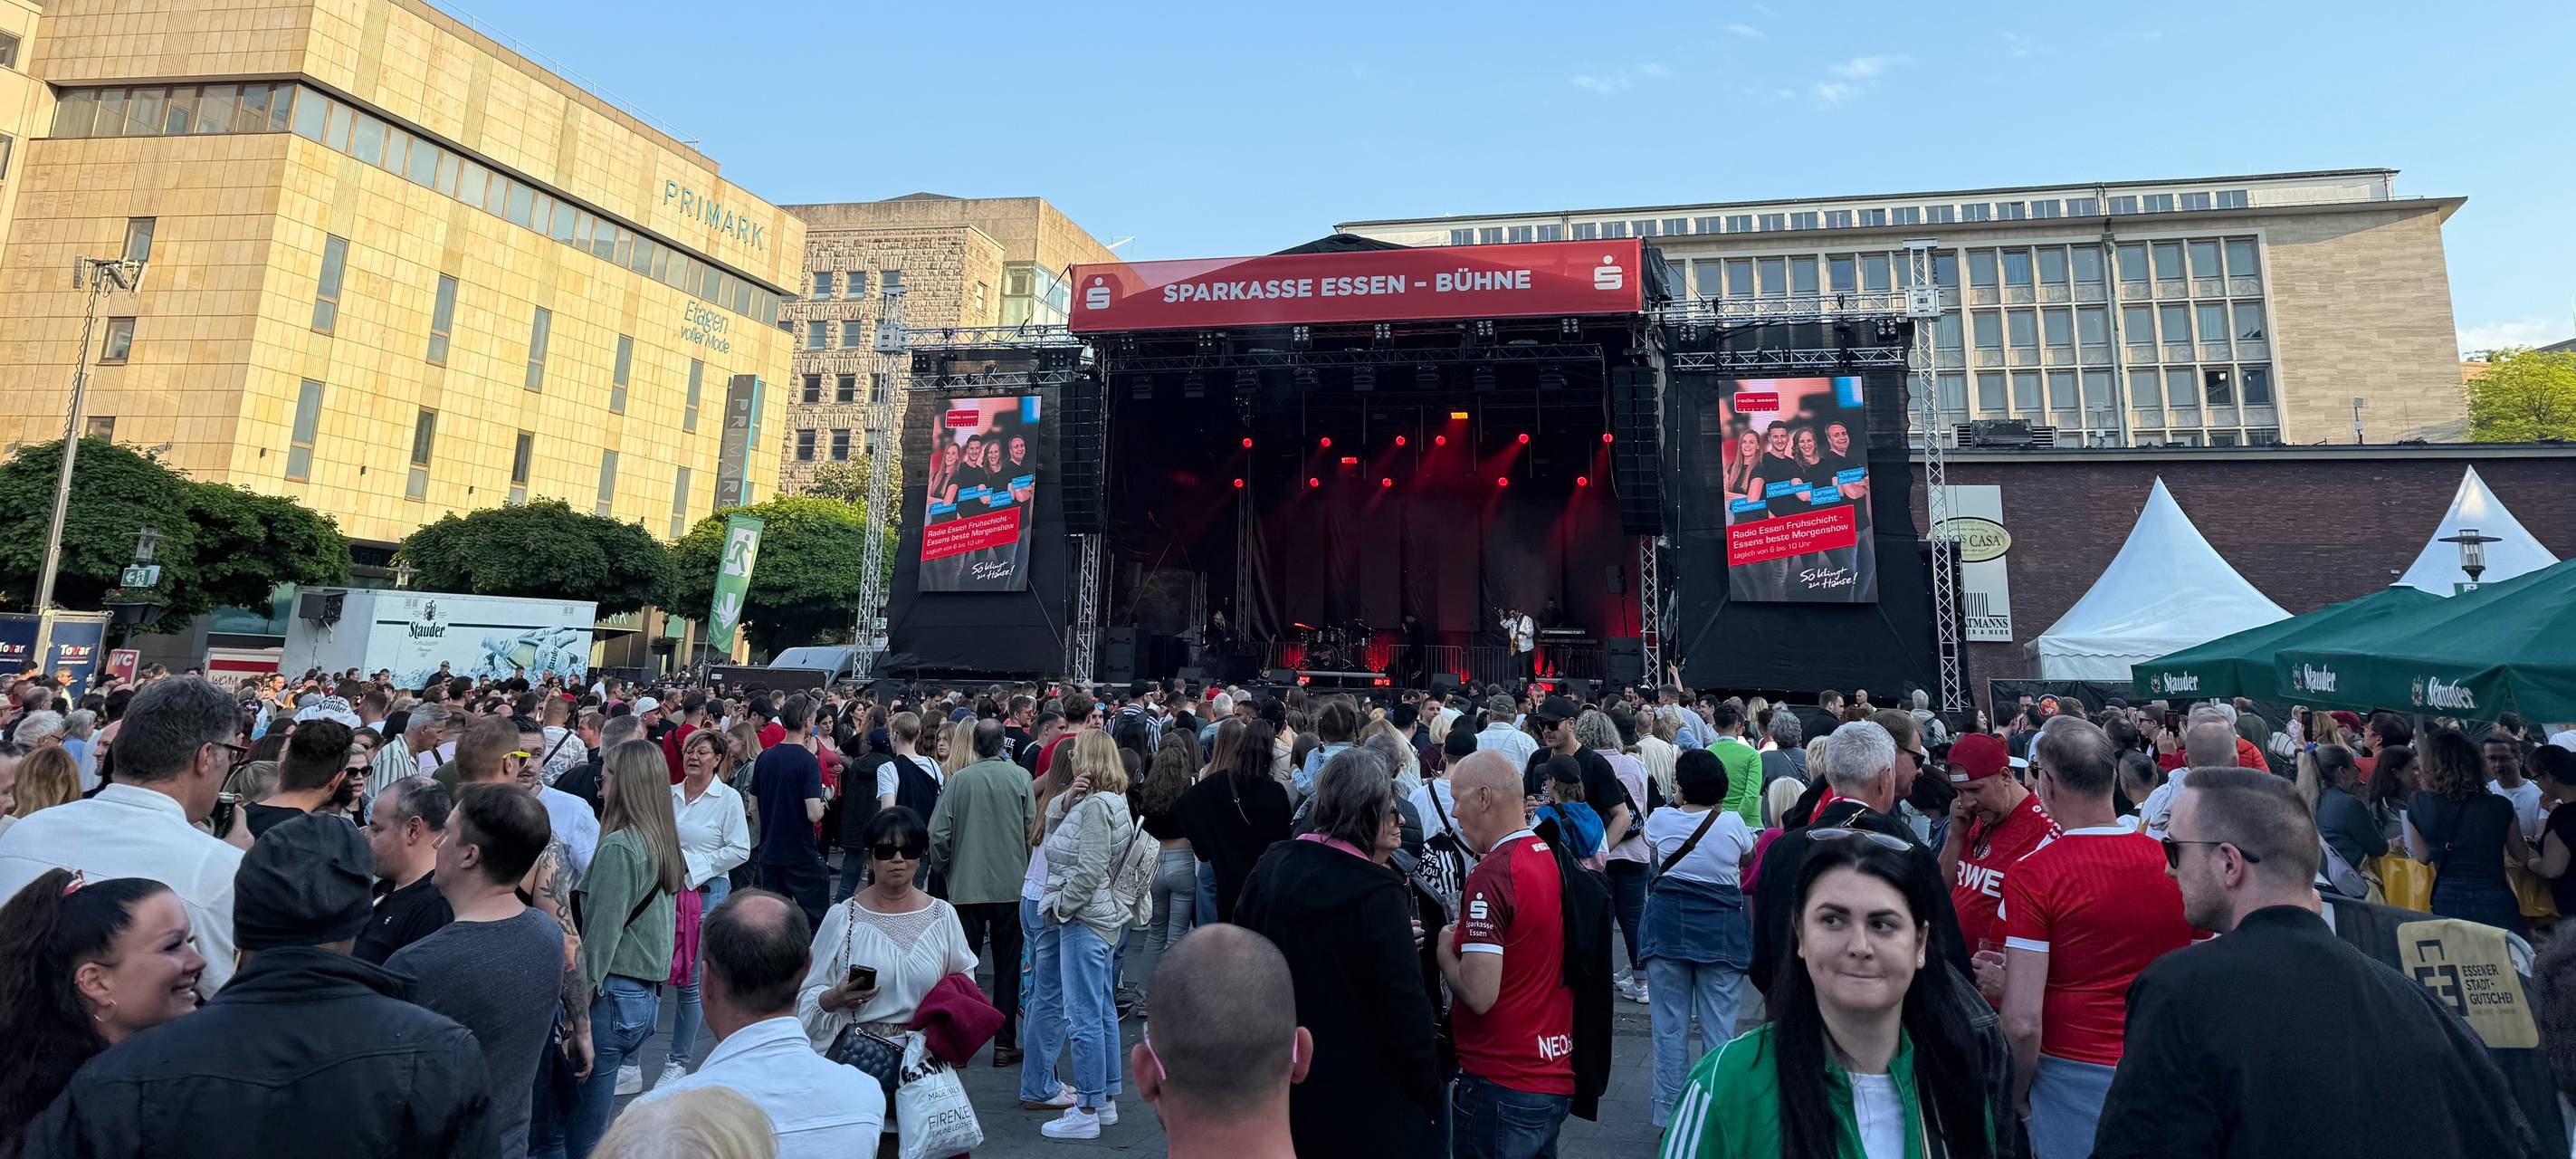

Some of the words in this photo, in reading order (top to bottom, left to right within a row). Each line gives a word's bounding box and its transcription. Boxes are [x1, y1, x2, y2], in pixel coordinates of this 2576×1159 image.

[663, 179, 766, 251] PRIMARK
[1163, 278, 1312, 303] SPARKASSE
[1321, 274, 1406, 297] ESSEN
[1436, 268, 1531, 292] BÜHNE
[683, 300, 730, 335] Etagen
[681, 325, 704, 347] voller
[705, 332, 730, 355] Mode
[927, 537, 950, 547] Essens
[951, 532, 970, 541] beste
[971, 523, 1015, 537] Morgenshow
[928, 530, 947, 538] Radio
[947, 524, 968, 534] Essen
[1732, 529, 1757, 539] Radio
[1759, 524, 1785, 535] Essen
[1733, 538, 1764, 550] Essens
[1766, 533, 1790, 544] beste
[1792, 523, 1848, 539] Morgenshow
[1757, 547, 1769, 555] von
[1770, 545, 1775, 553] 6
[1776, 544, 1787, 552] bis
[1798, 541, 1812, 549] Uhr
[1970, 534, 2001, 547] CASA
[971, 561, 984, 575] So
[984, 560, 1008, 572] klingt
[1799, 568, 1815, 583] So
[1816, 566, 1847, 580] klingt
[1808, 580, 1820, 589] zu
[408, 621, 445, 640] Stauder
[1967, 618, 2008, 628] TMANNS
[0, 642, 25, 653] Tovar
[60, 645, 91, 656] Tovar
[111, 653, 134, 666] WC
[2163, 670, 2199, 694] Stauder
[2304, 663, 2336, 693] Stauder
[2427, 675, 2477, 711] Stauder
[1465, 920, 1493, 931] Sparkasse
[1469, 929, 1487, 938] Essen
[2461, 963, 2500, 977] ESSENER
[2465, 979, 2495, 991] STADT-
